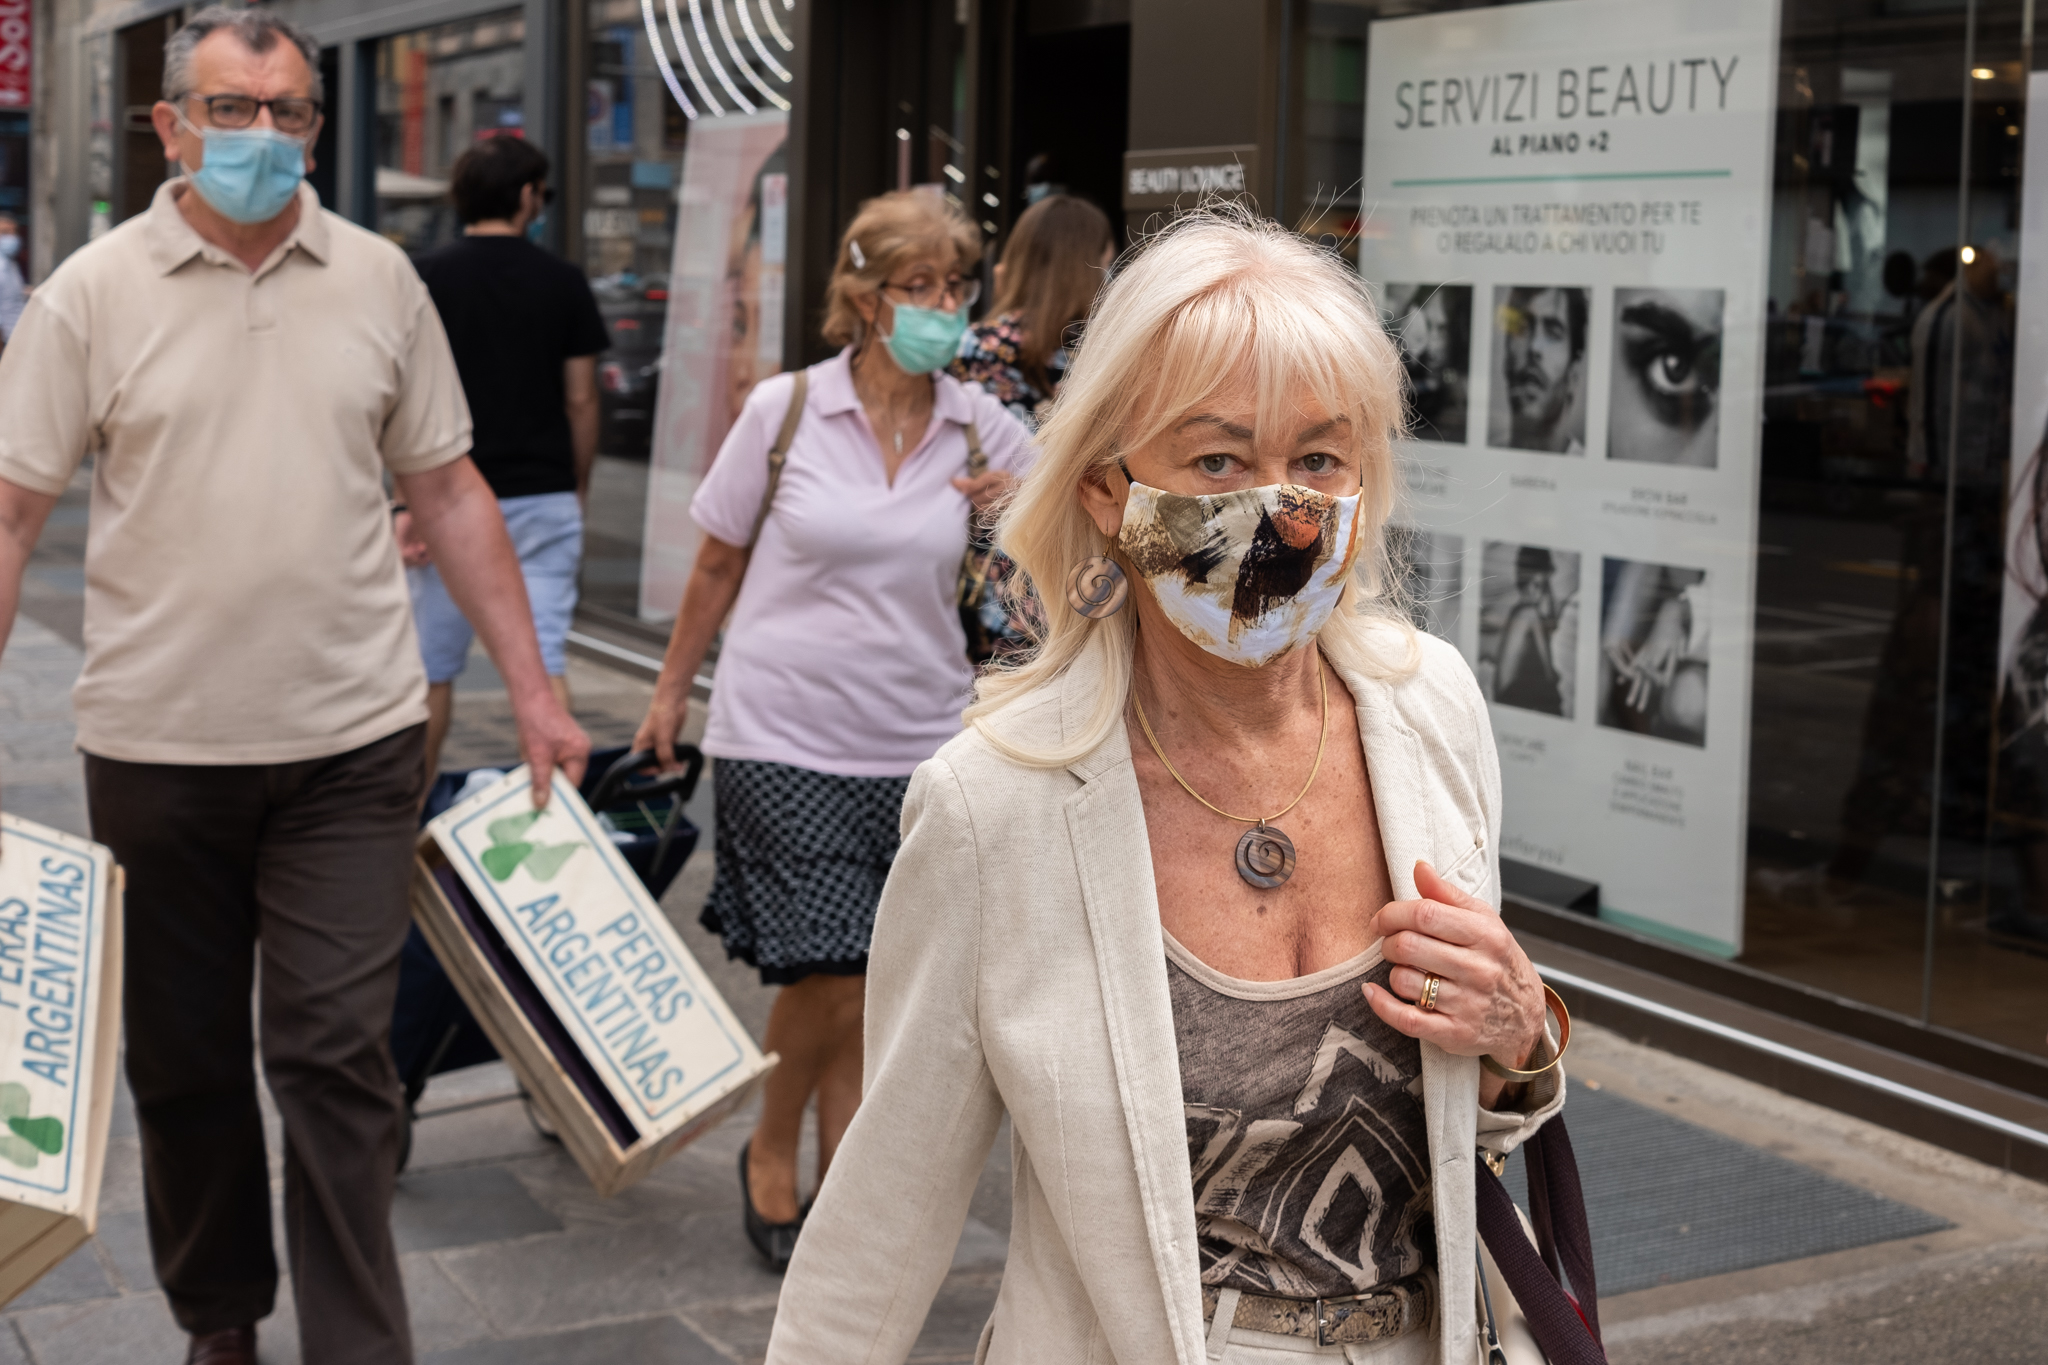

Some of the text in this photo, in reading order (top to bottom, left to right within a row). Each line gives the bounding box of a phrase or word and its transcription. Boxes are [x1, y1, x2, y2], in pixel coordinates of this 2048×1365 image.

[1394, 55, 1739, 130] SERVIZI BEAUTY
[1490, 131, 1610, 156] AL PIANO +2
[1129, 168, 1179, 194] BEAUTY
[1410, 200, 1702, 227] PRENOTA UN TRATTAMENTO PER TE
[1436, 230, 1665, 255] O REGALALO A CHI VUOI TU
[21, 856, 85, 1088] ARGENTINAS
[596, 910, 694, 1025] PERAS
[515, 892, 686, 1102] ARGENTINAS
